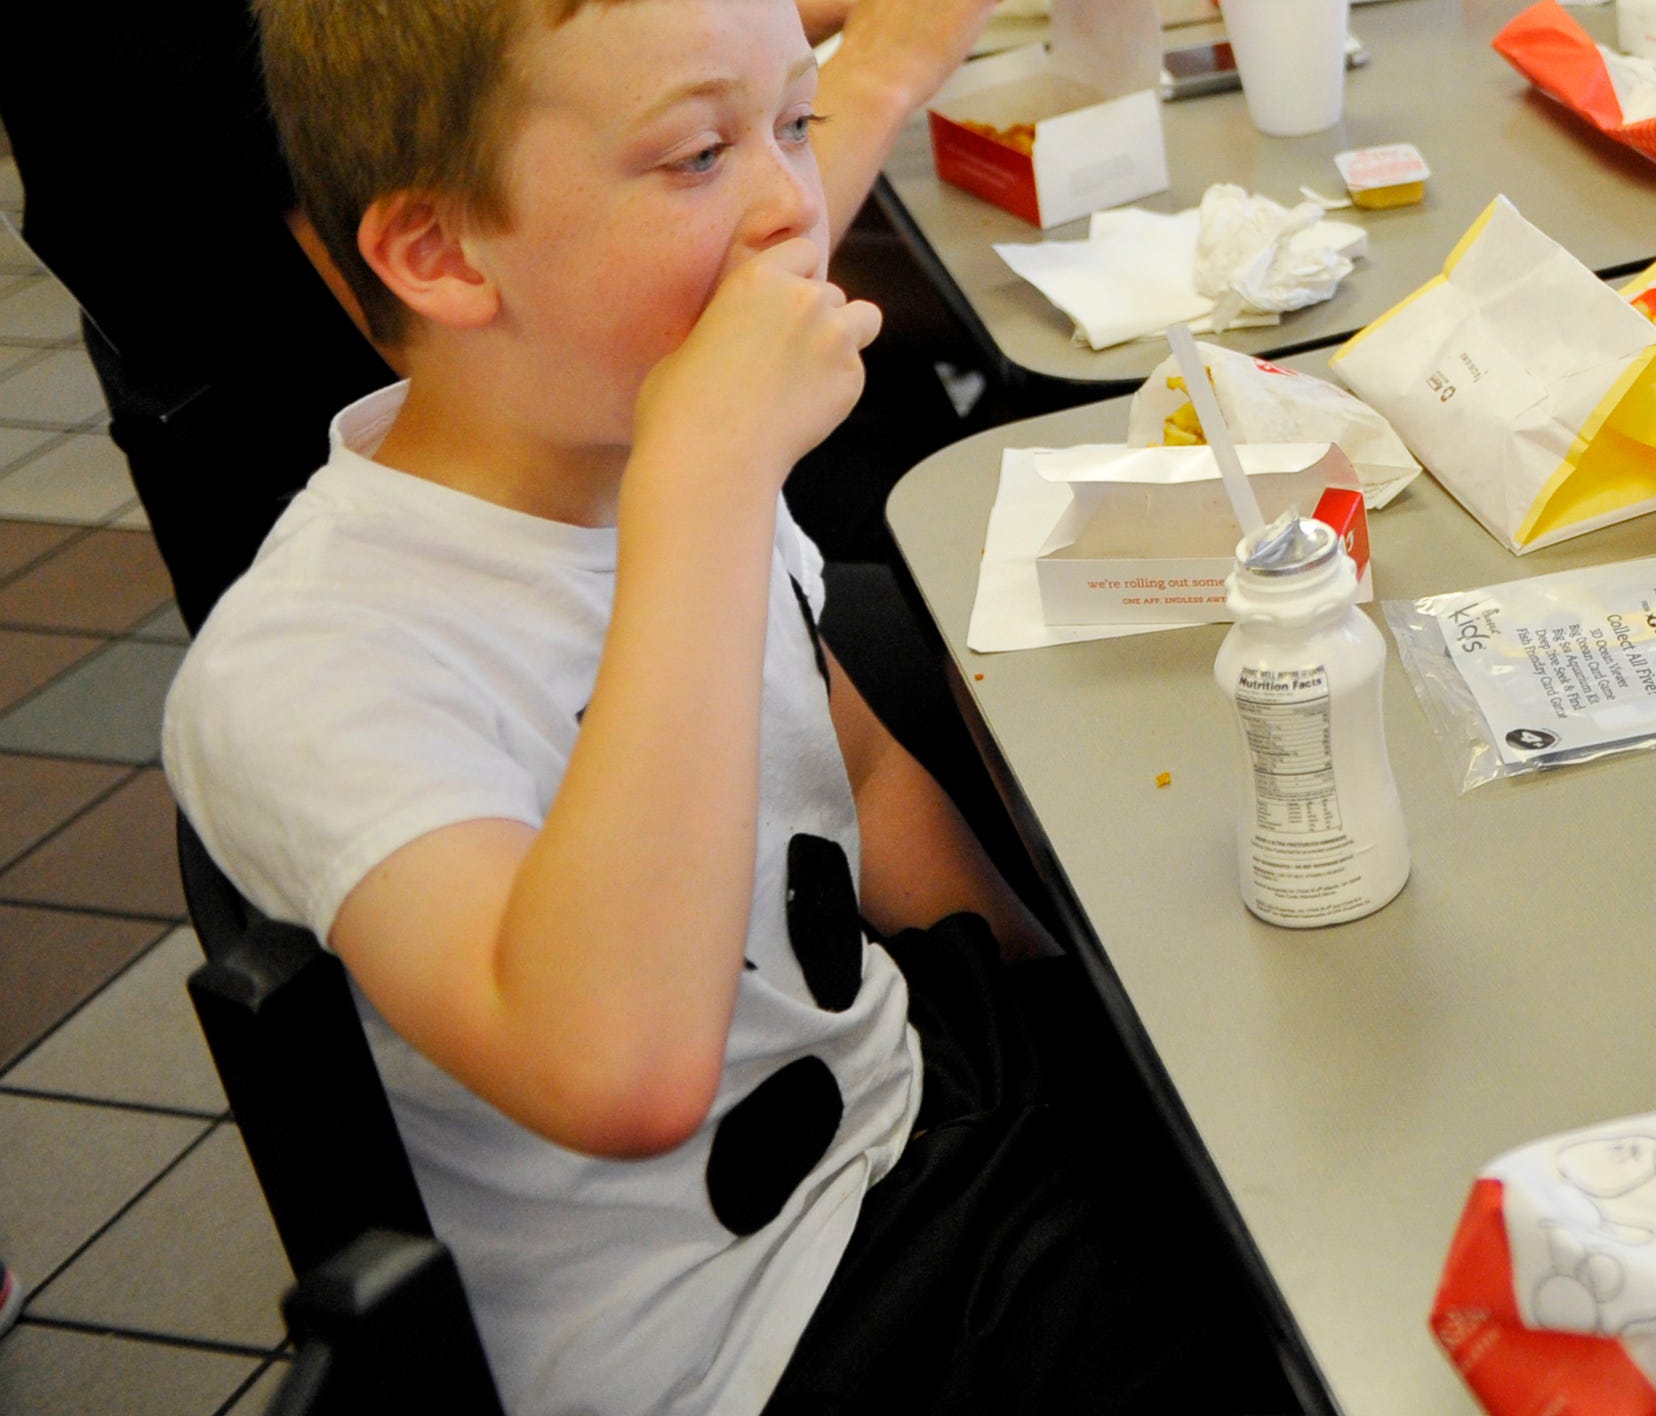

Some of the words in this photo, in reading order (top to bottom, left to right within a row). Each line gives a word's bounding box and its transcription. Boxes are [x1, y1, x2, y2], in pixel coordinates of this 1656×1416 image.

[1087, 578, 1121, 589] we're
[1123, 576, 1165, 592] rolling
[1167, 577, 1188, 588] out
[1121, 596, 1140, 605] ONE
[1164, 595, 1203, 605] ENDLESS
[1568, 623, 1583, 637] Big
[1606, 614, 1635, 651] Collect
[1626, 653, 1649, 668] All
[1576, 635, 1594, 661] Ocean
[1595, 639, 1614, 664] Ocean
[1516, 627, 1532, 646] Fish
[1540, 676, 1557, 696] Card
[1550, 695, 1567, 719] Game
[1535, 628, 1550, 648] Deep
[1546, 648, 1560, 666] Dive
[1553, 666, 1569, 684] Seek
[1568, 692, 1586, 711] Find
[1565, 654, 1592, 693] Aquarium
[1591, 661, 1607, 680] Card
[1239, 676, 1289, 692] Nutrition
[1292, 678, 1322, 690] Facts
[1598, 679, 1616, 700] Game
